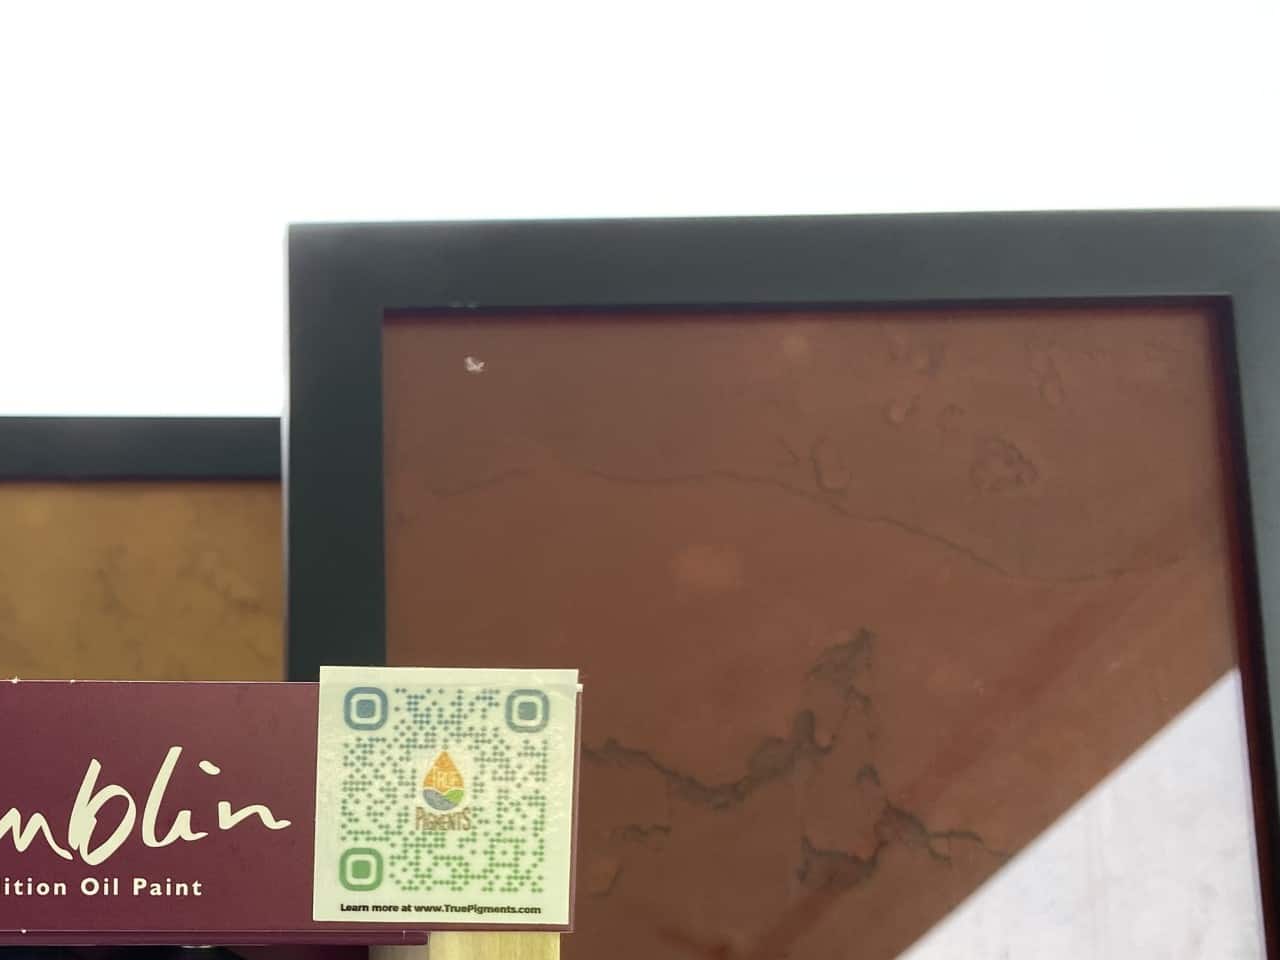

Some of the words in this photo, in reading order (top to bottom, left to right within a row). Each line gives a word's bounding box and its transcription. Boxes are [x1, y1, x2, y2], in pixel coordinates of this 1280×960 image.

[80, 878, 119, 896] Oil
[133, 878, 202, 896] Paint
[340, 903, 369, 913] Learn
[372, 904, 399, 913] more
[401, 904, 413, 913] at
[414, 904, 541, 915] www.TruePigments.com
